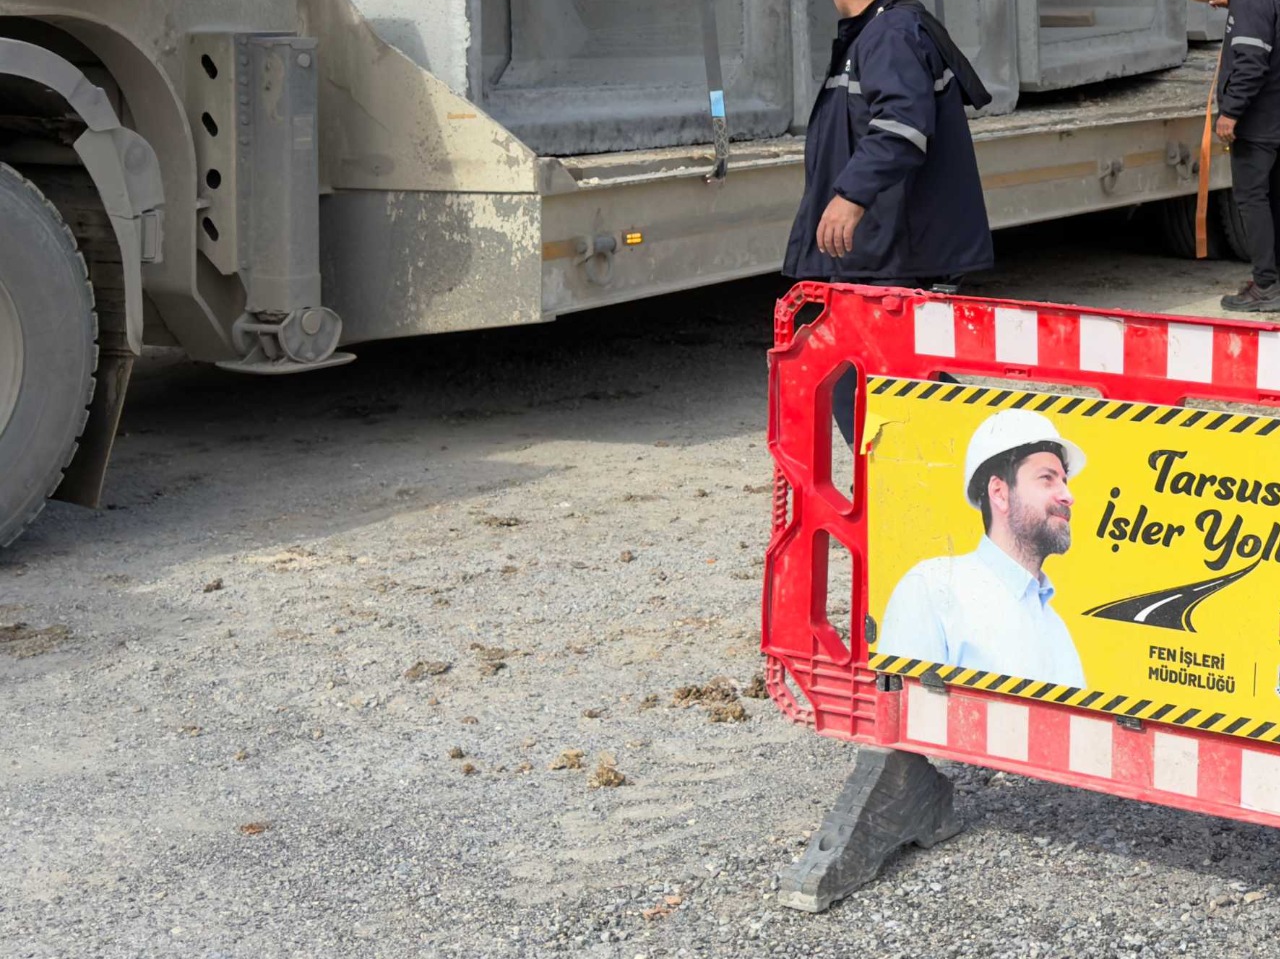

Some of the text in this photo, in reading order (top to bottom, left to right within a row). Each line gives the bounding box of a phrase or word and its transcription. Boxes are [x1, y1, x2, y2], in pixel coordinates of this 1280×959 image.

[1096, 486, 1186, 553] İşler
[1149, 645, 1225, 671] FEN İŞLERİ
[1148, 664, 1236, 694] MÜDÜRLÜĞÜ
